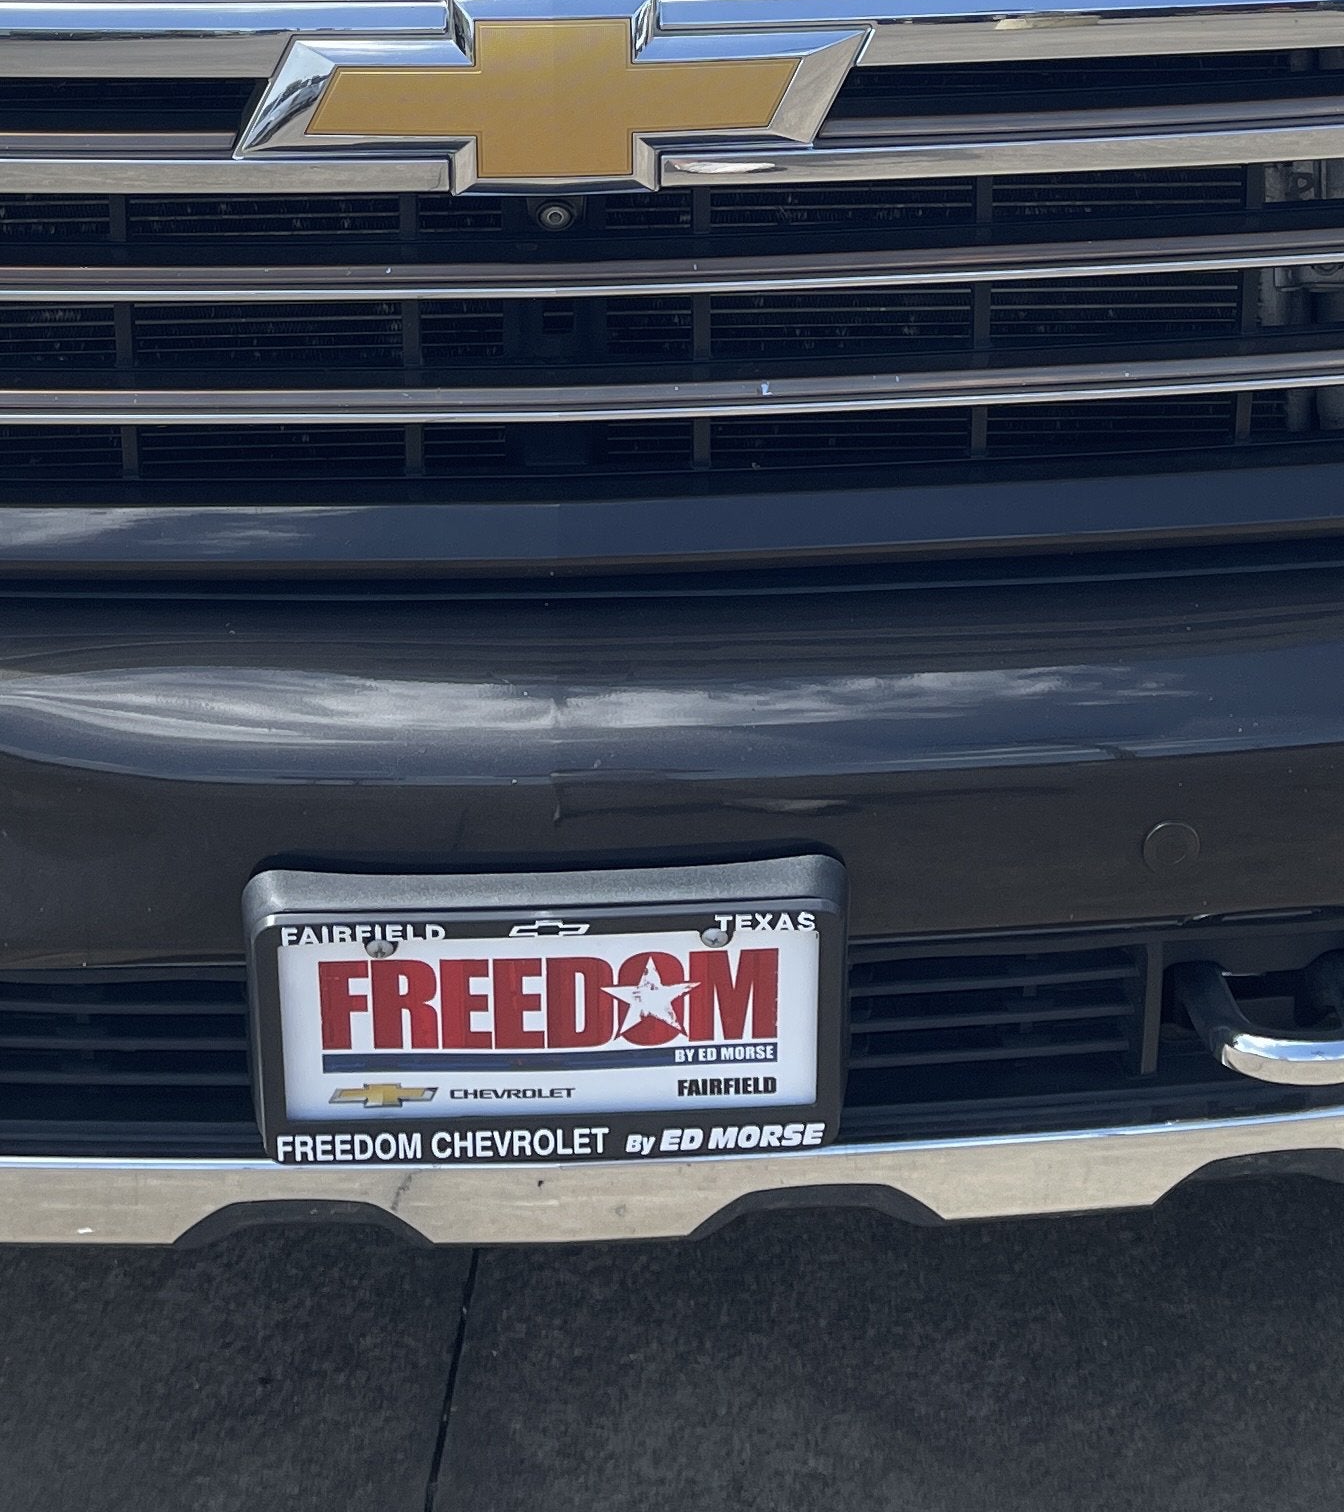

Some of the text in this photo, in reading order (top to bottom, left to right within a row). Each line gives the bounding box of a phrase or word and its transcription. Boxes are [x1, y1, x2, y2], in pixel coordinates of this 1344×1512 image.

[714, 911, 816, 932] TEXAS
[281, 923, 446, 947] FAIRFIELD
[318, 948, 779, 1050] FREEDOM
[674, 1045, 775, 1063] BY ED MORSE
[449, 1087, 576, 1100] CHEVROLET
[677, 1076, 777, 1097] FAIRFIELD
[276, 1122, 826, 1162] FREEDOM CHEVROLET By ED MORSE
